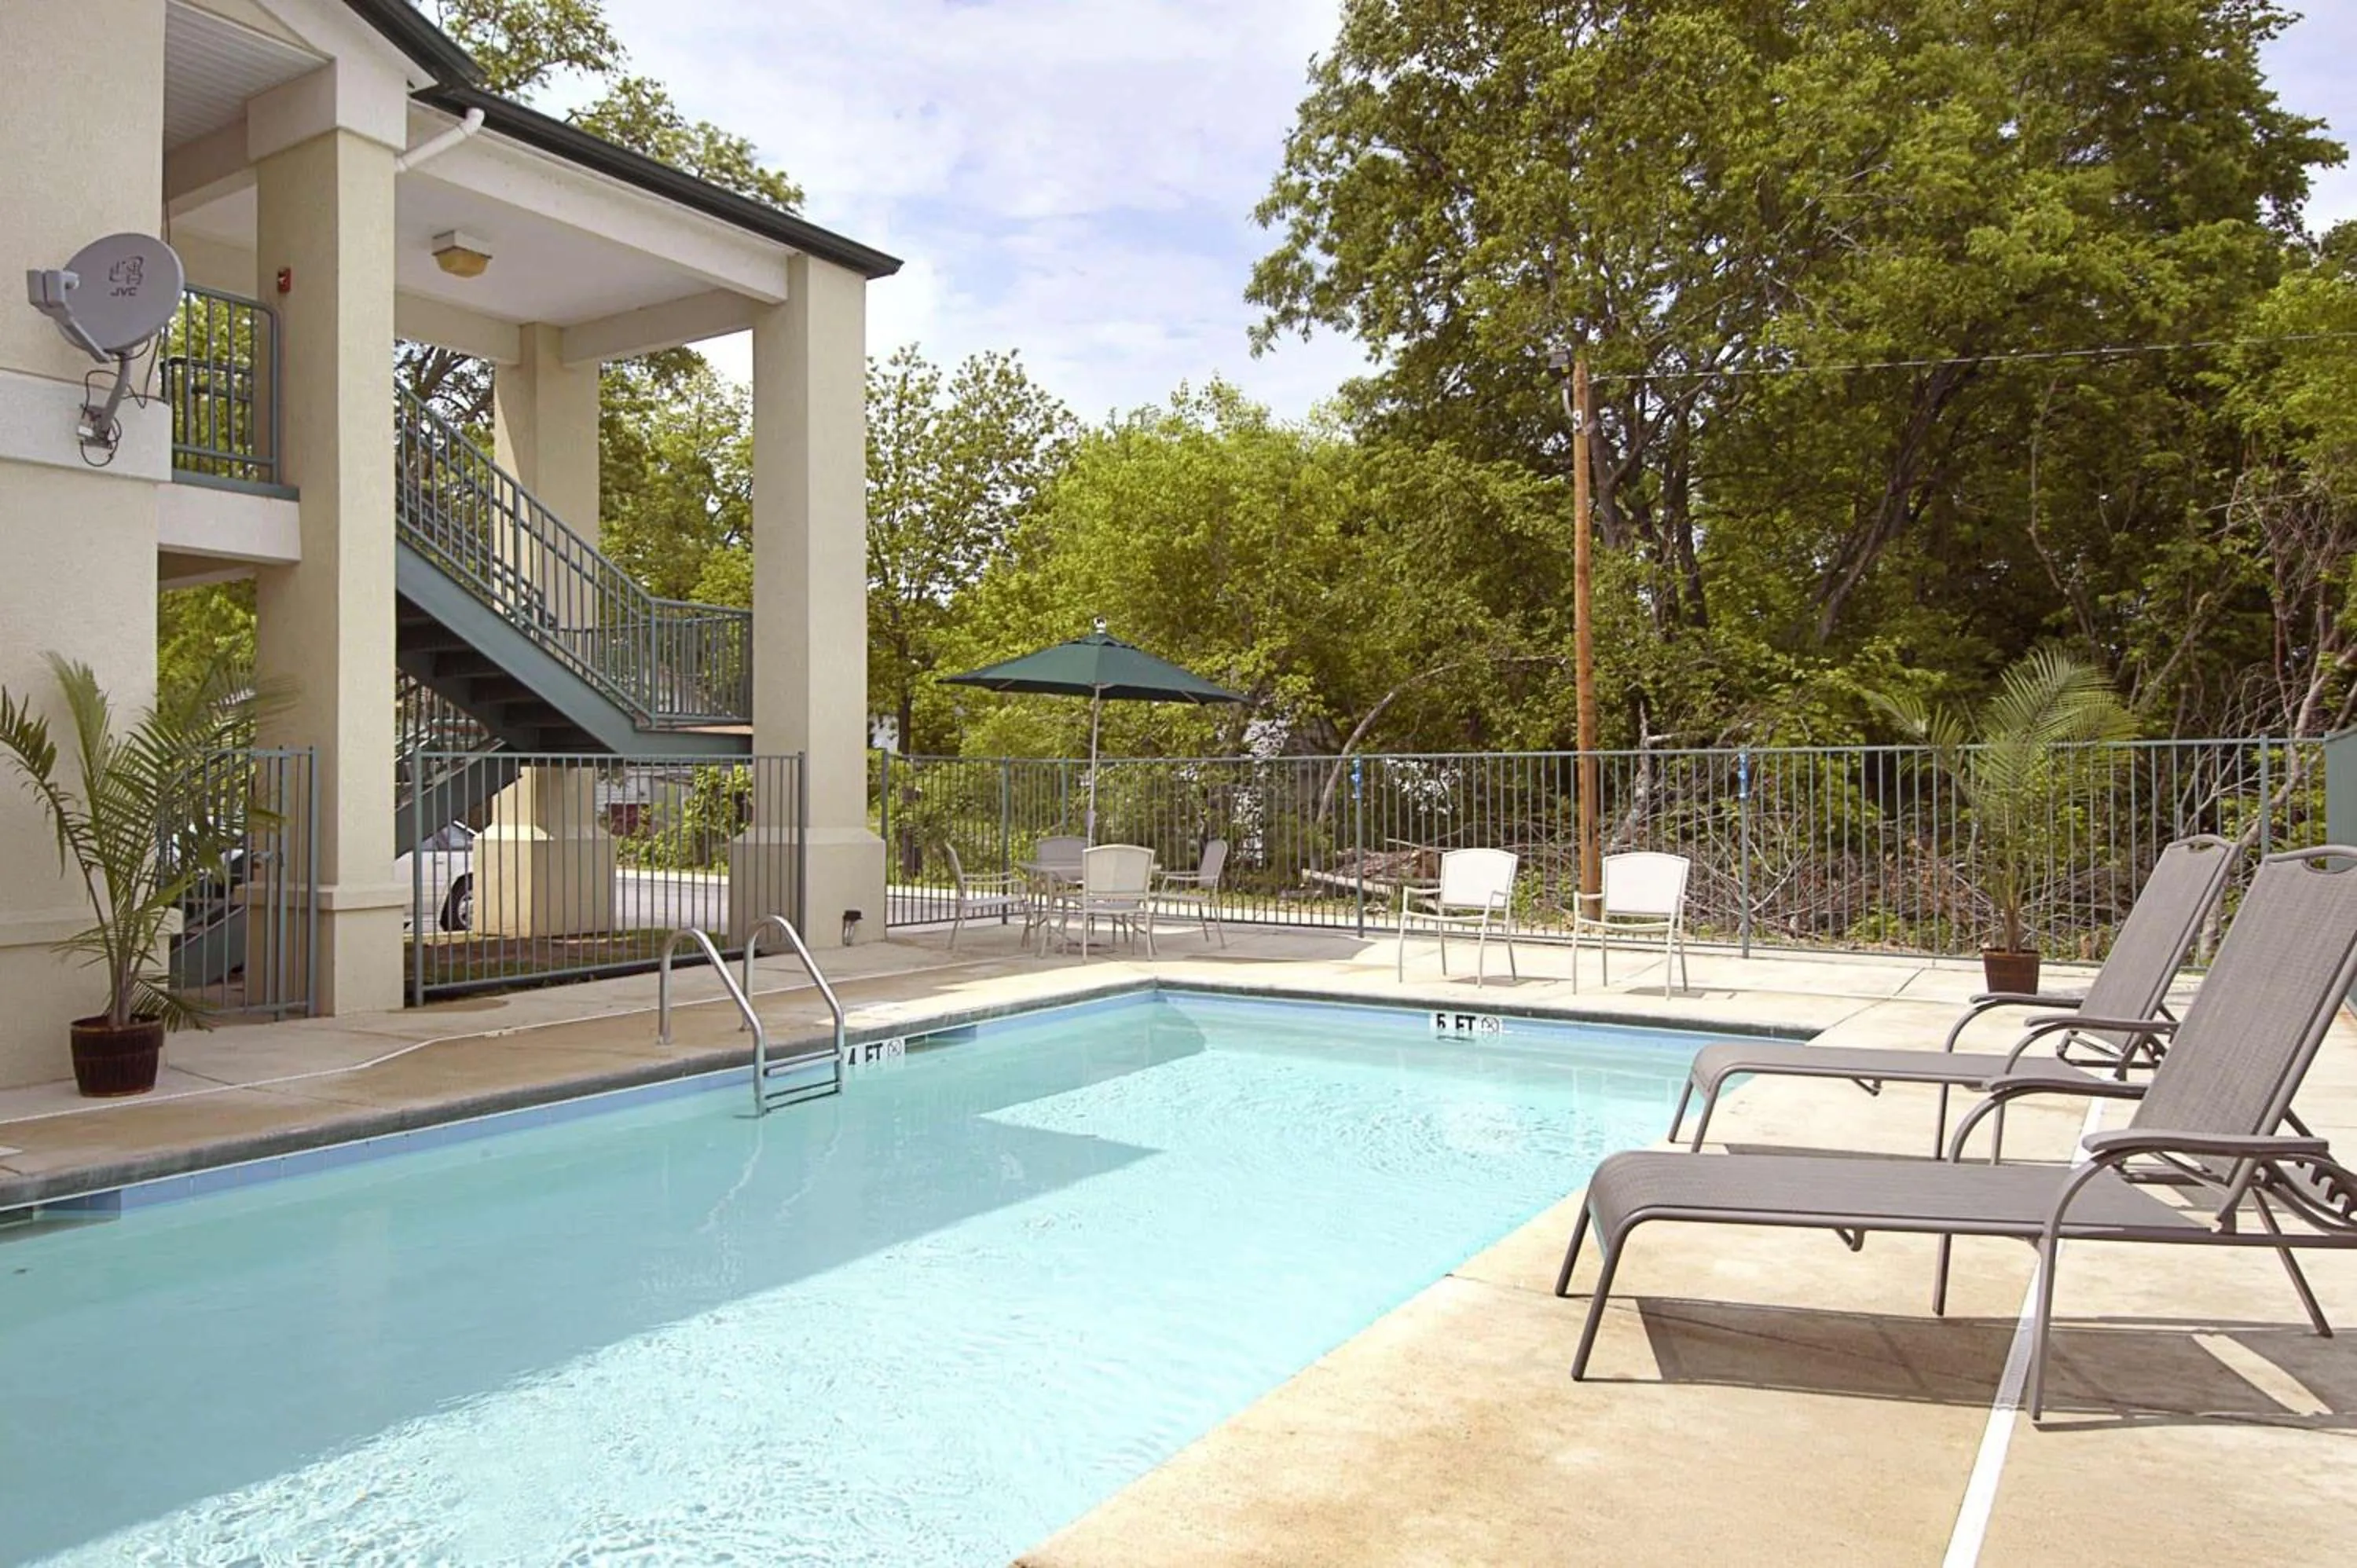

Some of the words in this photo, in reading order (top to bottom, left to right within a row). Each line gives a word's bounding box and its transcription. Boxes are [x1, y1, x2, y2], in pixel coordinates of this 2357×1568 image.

[110, 287, 137, 297] JVC
[1455, 1014, 1476, 1031] FT
[865, 1042, 883, 1063] FT
